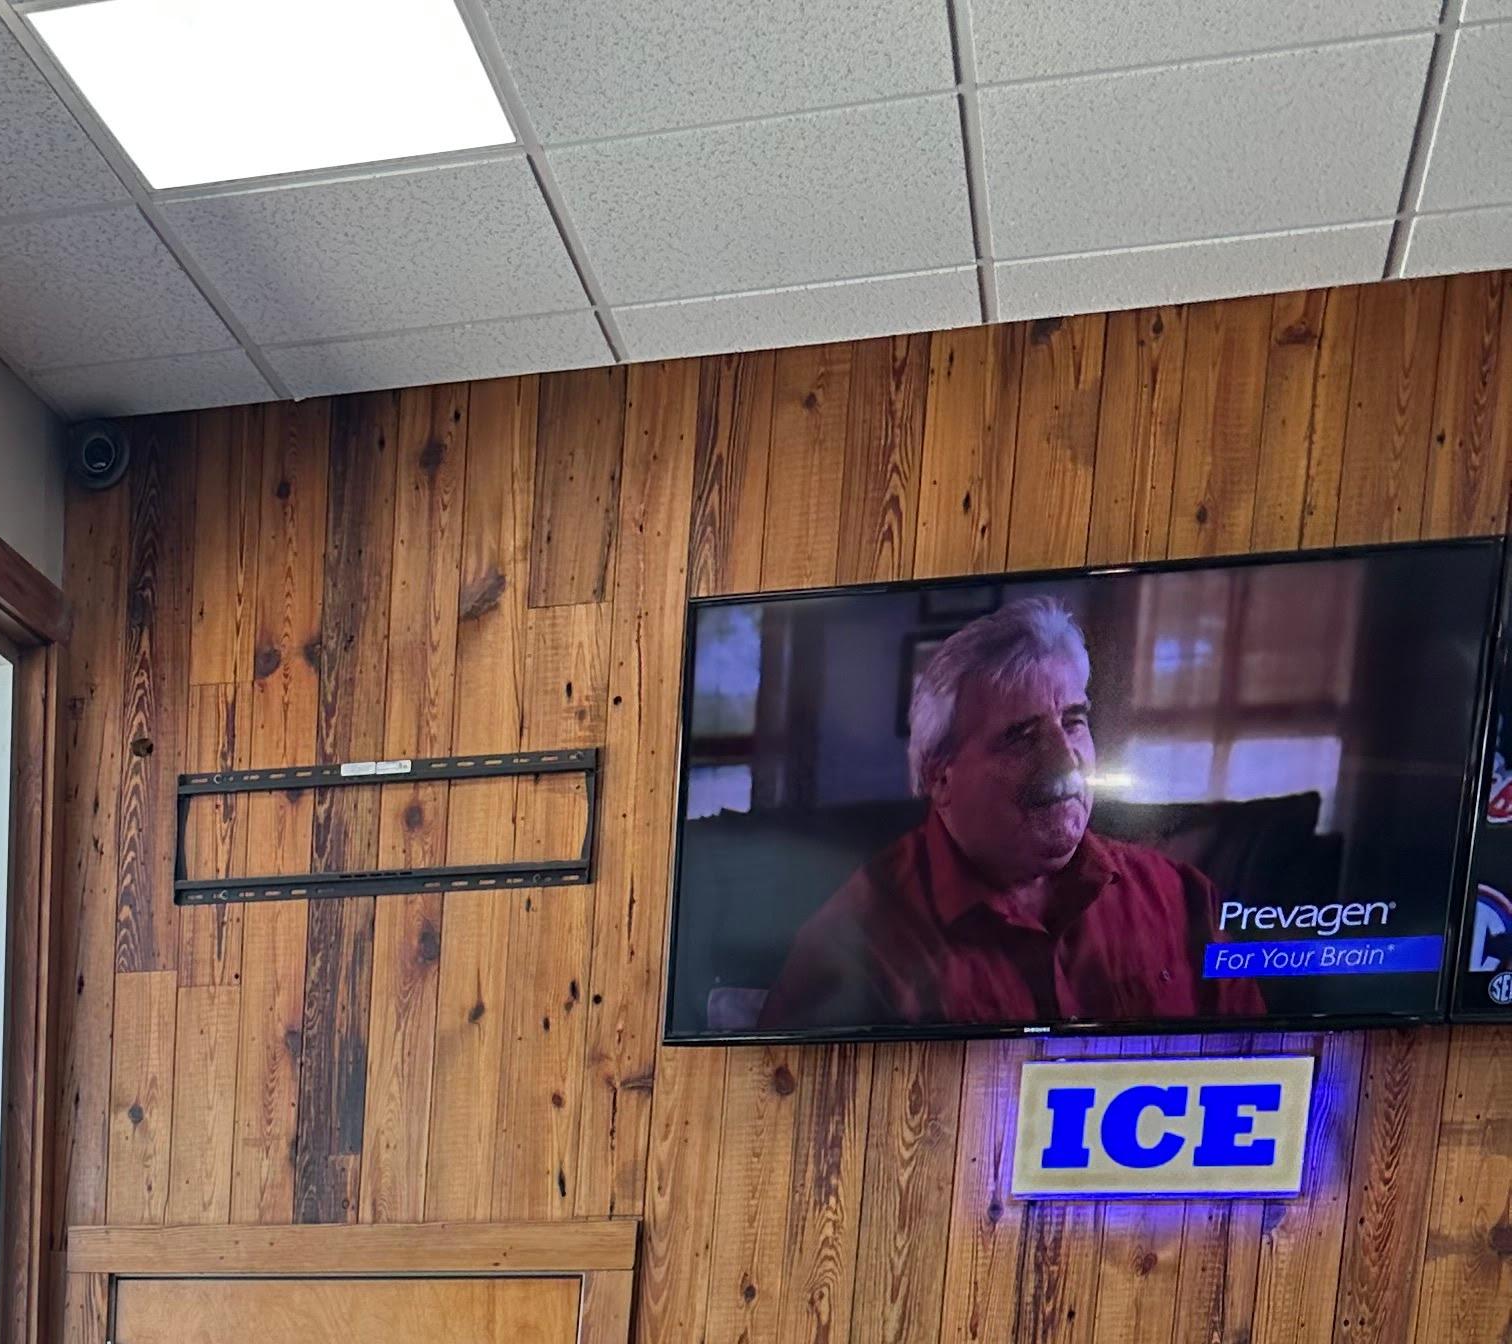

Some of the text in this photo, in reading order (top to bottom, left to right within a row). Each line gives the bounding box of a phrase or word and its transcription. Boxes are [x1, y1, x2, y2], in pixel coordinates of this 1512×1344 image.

[1215, 950, 1255, 971] For
[1262, 948, 1316, 970] Your
[1041, 1084, 1282, 1169] ICE
